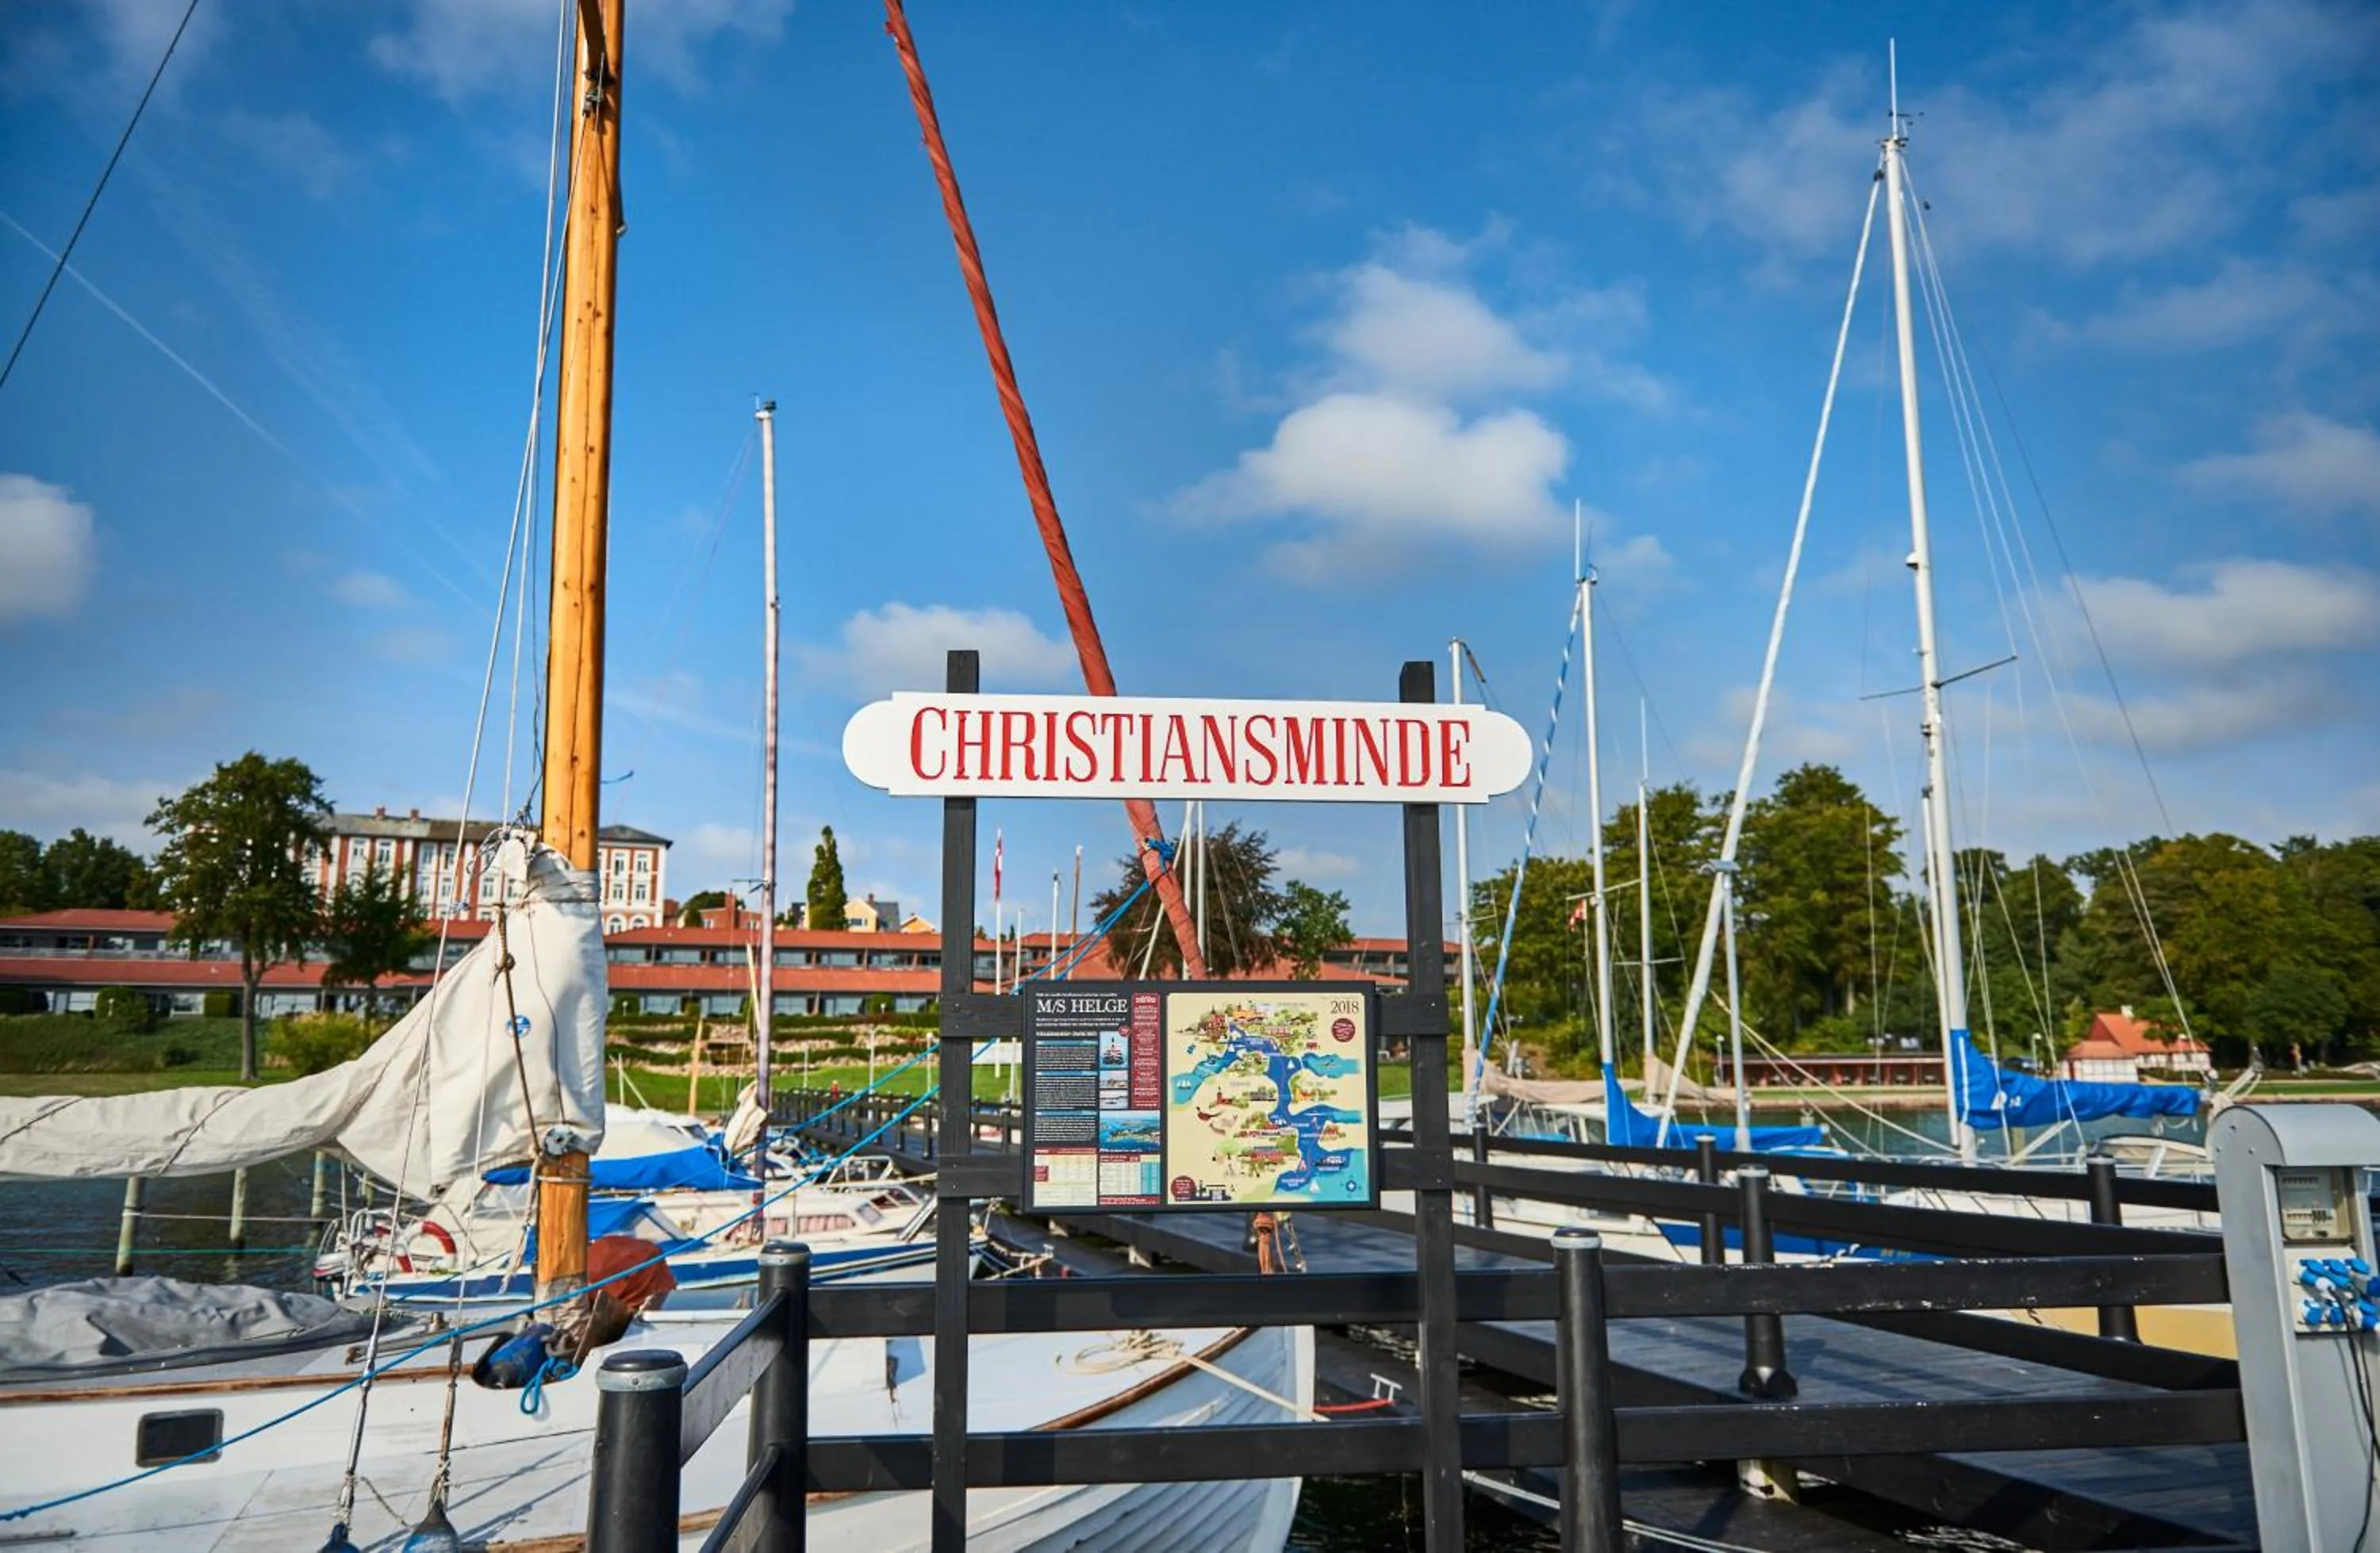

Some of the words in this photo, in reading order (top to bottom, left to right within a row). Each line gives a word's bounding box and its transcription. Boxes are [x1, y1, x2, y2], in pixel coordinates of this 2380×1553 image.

[910, 706, 1472, 788] CHRISTIANSMINDE
[1036, 999, 1066, 1014] M/S
[1070, 999, 1128, 1014] HELGE
[1330, 1000, 1359, 1014] 2018
